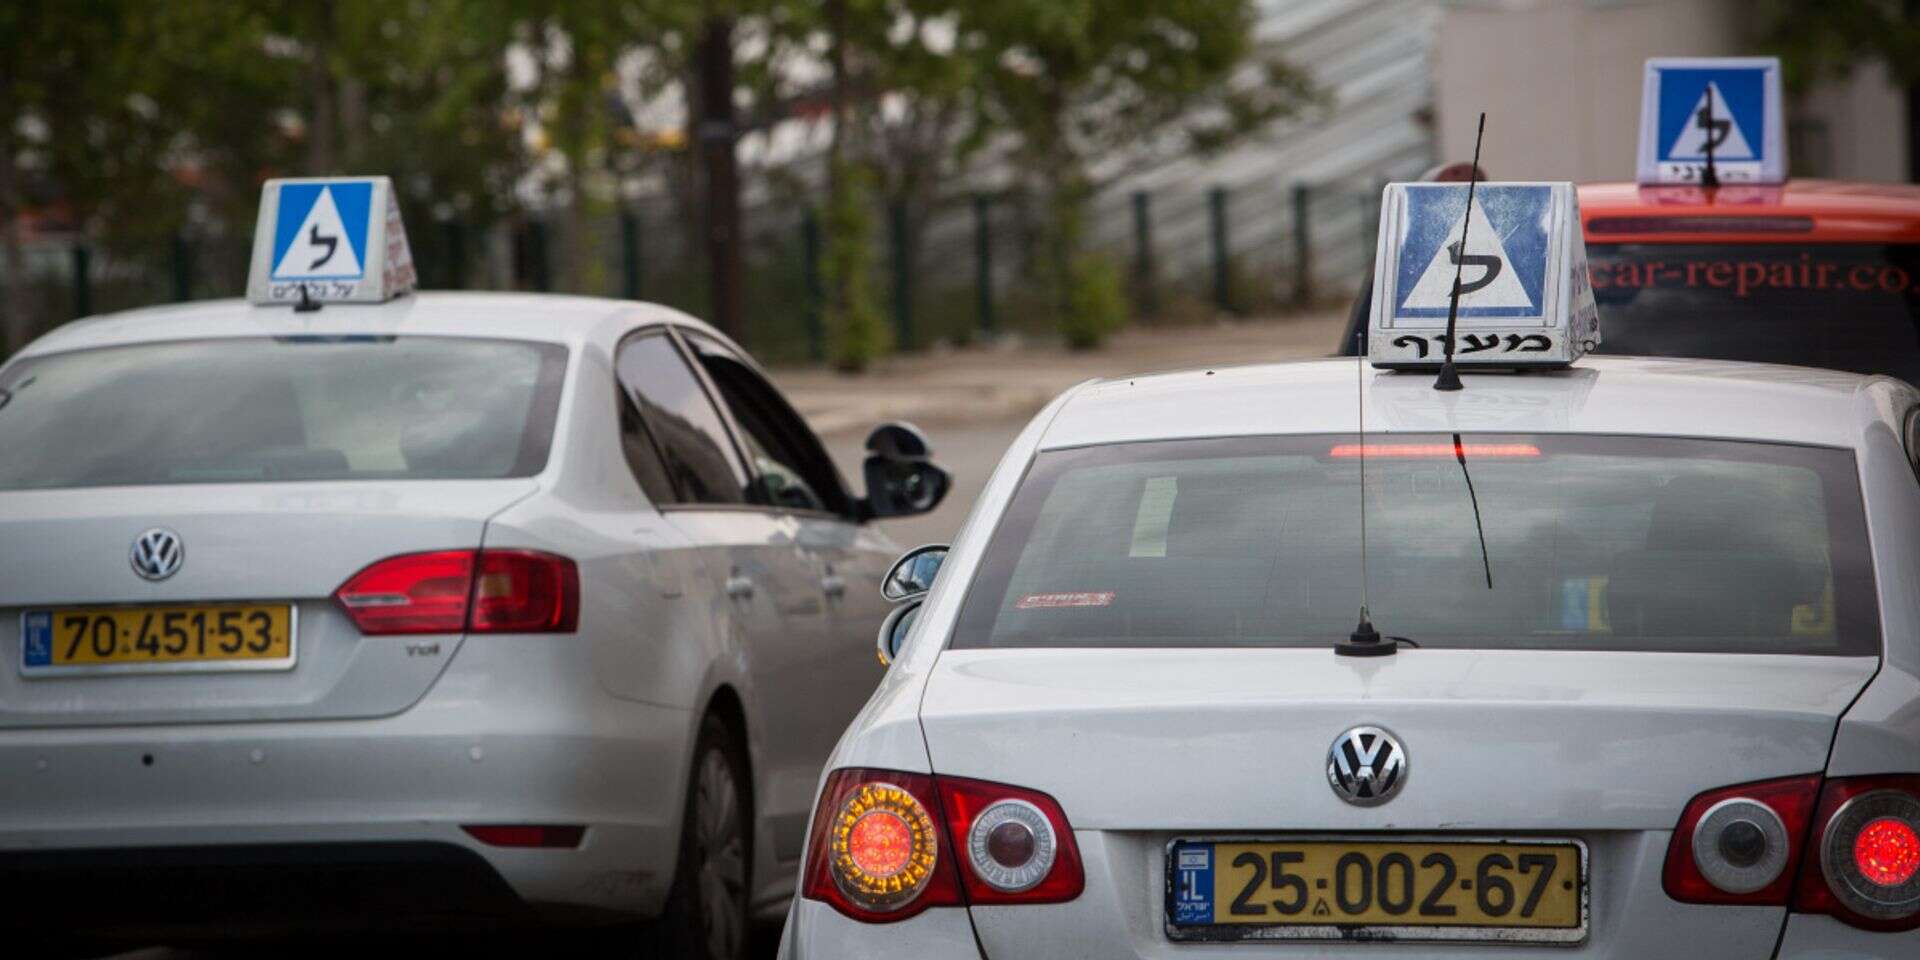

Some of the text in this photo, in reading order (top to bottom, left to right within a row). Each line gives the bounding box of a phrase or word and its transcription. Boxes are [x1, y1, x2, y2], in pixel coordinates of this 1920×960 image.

[1696, 107, 1732, 154] ל
[309, 224, 338, 271] ל
[1447, 240, 1502, 297] ל
[1329, 726, 1407, 806] VW
[1183, 870, 1205, 901] IL
